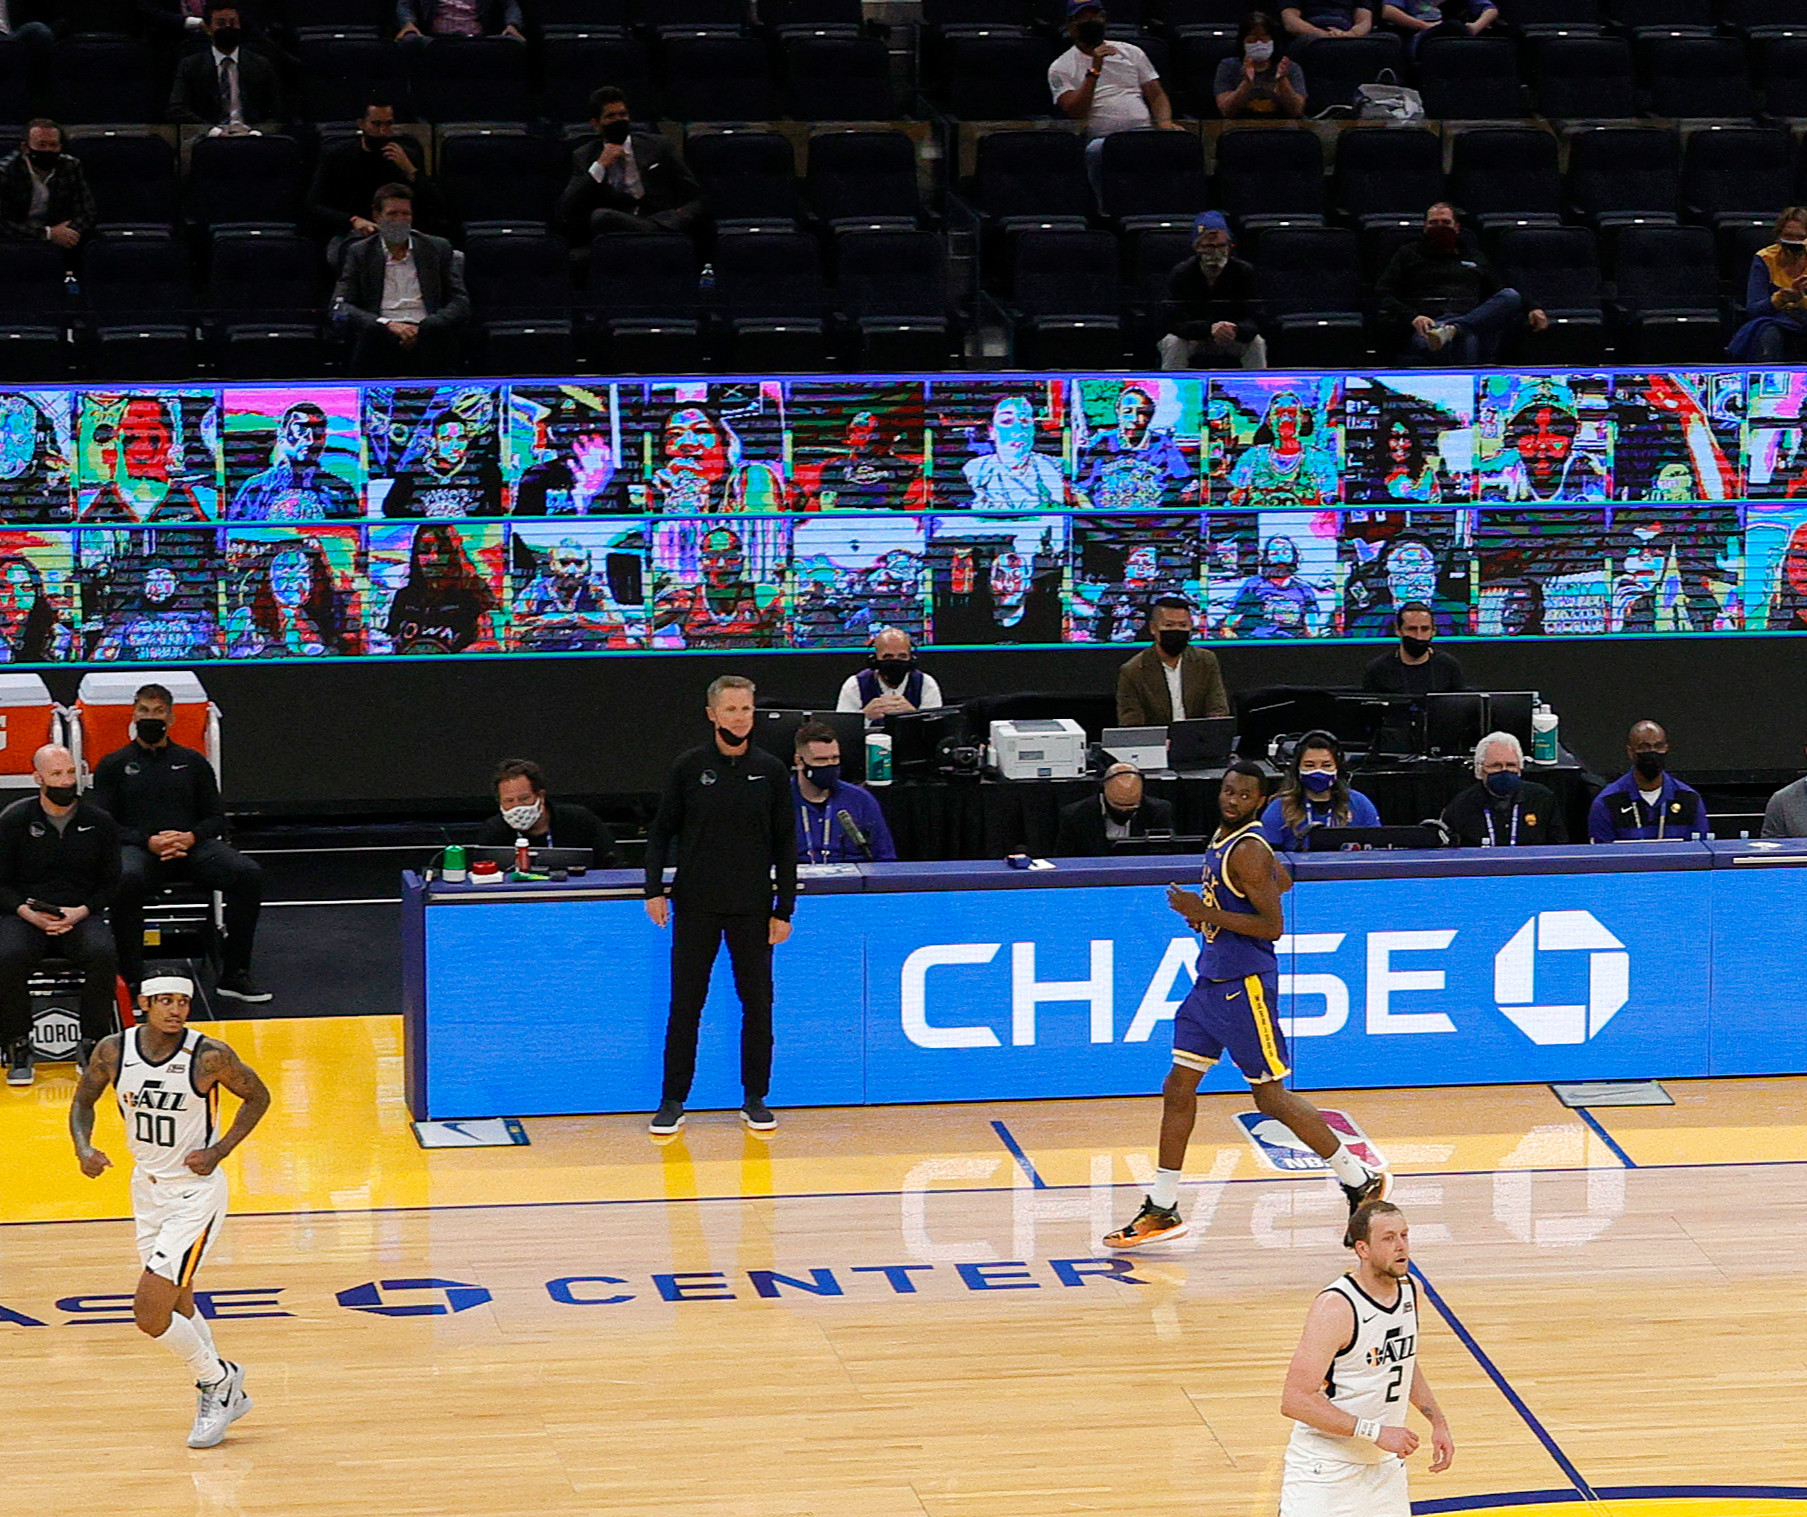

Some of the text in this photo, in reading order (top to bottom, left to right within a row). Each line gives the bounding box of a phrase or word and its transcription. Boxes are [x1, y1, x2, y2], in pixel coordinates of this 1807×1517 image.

[122, 1080, 190, 1113] JAZZ
[135, 1111, 178, 1148] 00
[545, 1257, 1150, 1306] CENTER
[1366, 1327, 1416, 1368] JAZZ
[1383, 1365, 1403, 1403] 2
